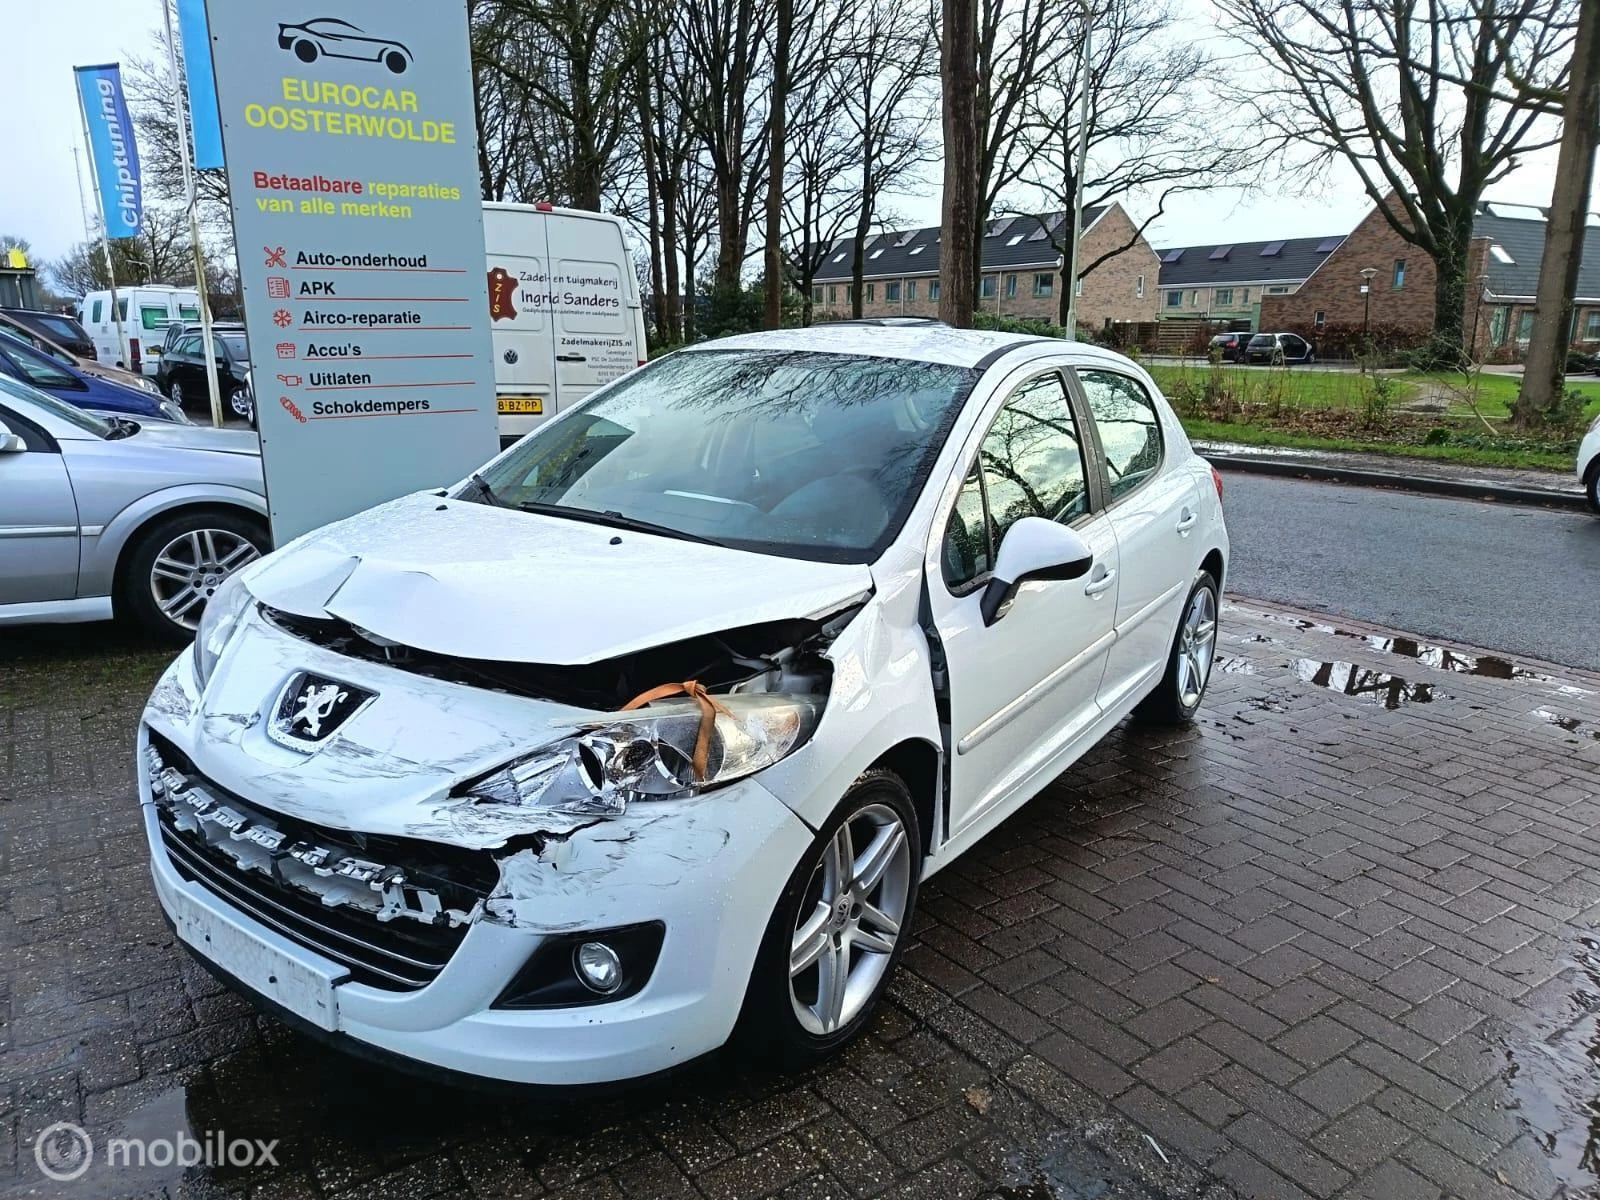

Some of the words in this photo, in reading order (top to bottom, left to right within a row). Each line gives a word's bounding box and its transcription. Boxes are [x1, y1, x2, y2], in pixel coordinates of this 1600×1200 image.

[281, 77, 418, 113] EUROCAR
[244, 103, 456, 144] OOSTERWOLDE
[96, 78, 139, 228] chiptuning
[253, 171, 363, 195] Betaalbare
[368, 182, 461, 201] reparaties
[255, 197, 294, 213] van
[300, 197, 336, 215] alle
[341, 201, 412, 219] merken
[296, 250, 427, 268] Auto-onderhoud
[299, 281, 336, 296] APK
[566, 275, 618, 290] tuigmakerij
[521, 290, 560, 307] Ingrid
[563, 292, 620, 307] Sanders
[303, 310, 421, 327] Airco-reparatie
[306, 342, 362, 358] Accu's
[309, 371, 371, 386] Uitlaten
[312, 399, 430, 415] Schokdempers
[498, 400, 538, 411] 8-BZ-PP
